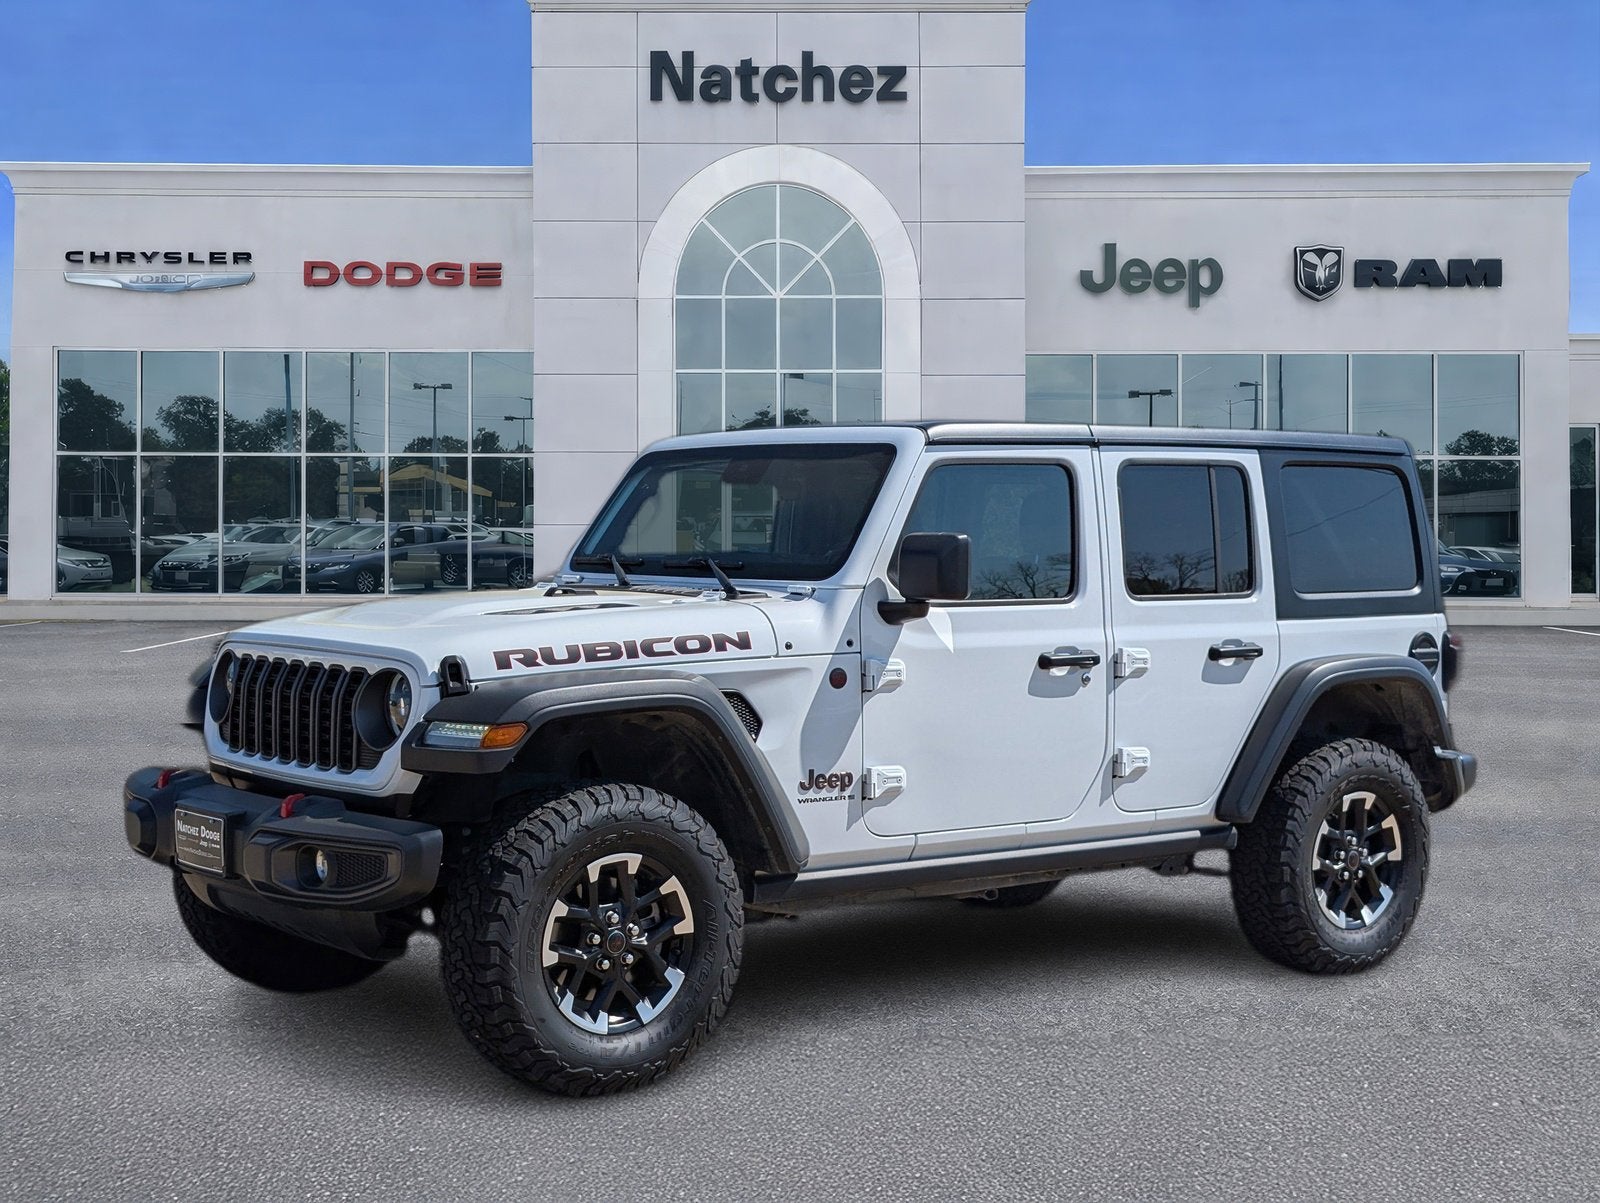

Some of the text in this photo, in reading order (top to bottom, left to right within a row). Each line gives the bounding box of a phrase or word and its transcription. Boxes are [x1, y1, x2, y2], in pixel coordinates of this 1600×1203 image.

[650, 51, 908, 103] Natchez
[65, 251, 252, 264] CHRYSLER
[304, 261, 502, 287] DODGE
[1080, 243, 1224, 308] Jeep
[1354, 259, 1502, 287] RAM
[493, 631, 752, 671] RUBICON
[800, 769, 854, 792] Jeep
[797, 796, 846, 804] WRANGLER
